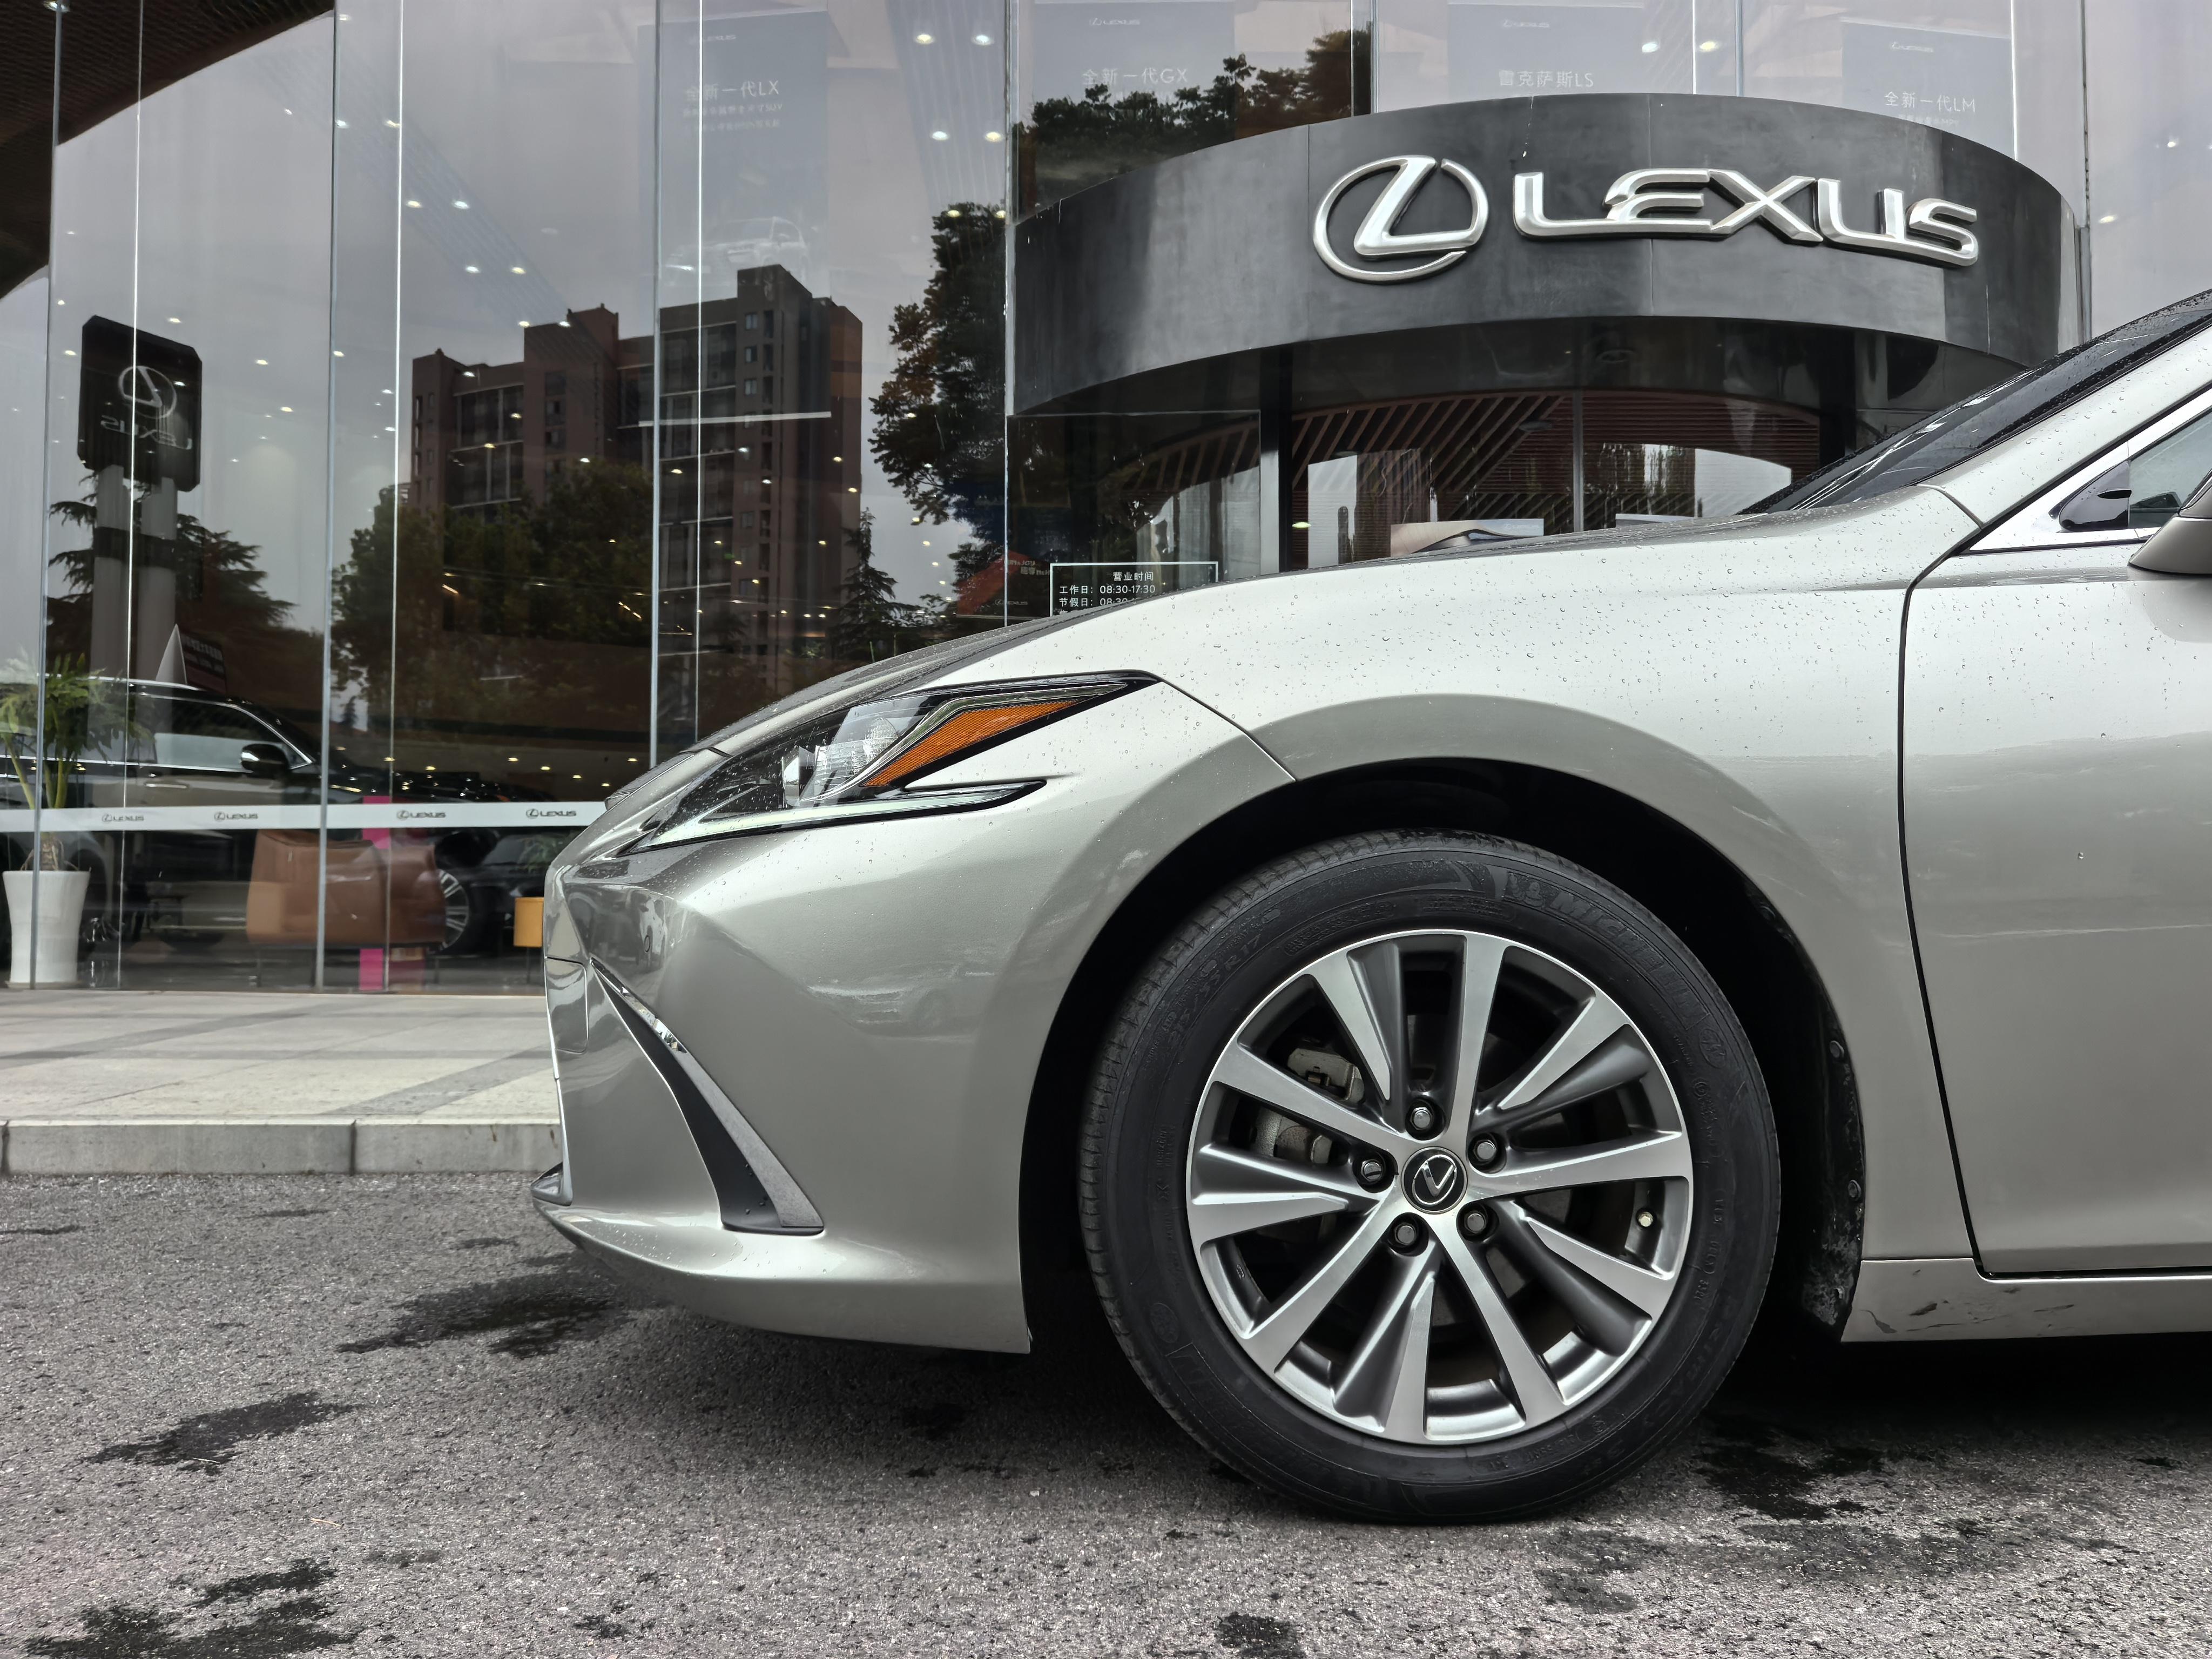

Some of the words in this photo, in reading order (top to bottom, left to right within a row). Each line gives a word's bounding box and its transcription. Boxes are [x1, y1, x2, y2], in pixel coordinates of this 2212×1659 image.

[1499, 70, 1594, 88] 雷克萨斯LS
[1884, 91, 1977, 113] 全新一代LM
[1513, 168, 1979, 267] LEXUS
[1113, 571, 1154, 582] 营业时间
[1100, 585, 1156, 594] 08:30-17:30
